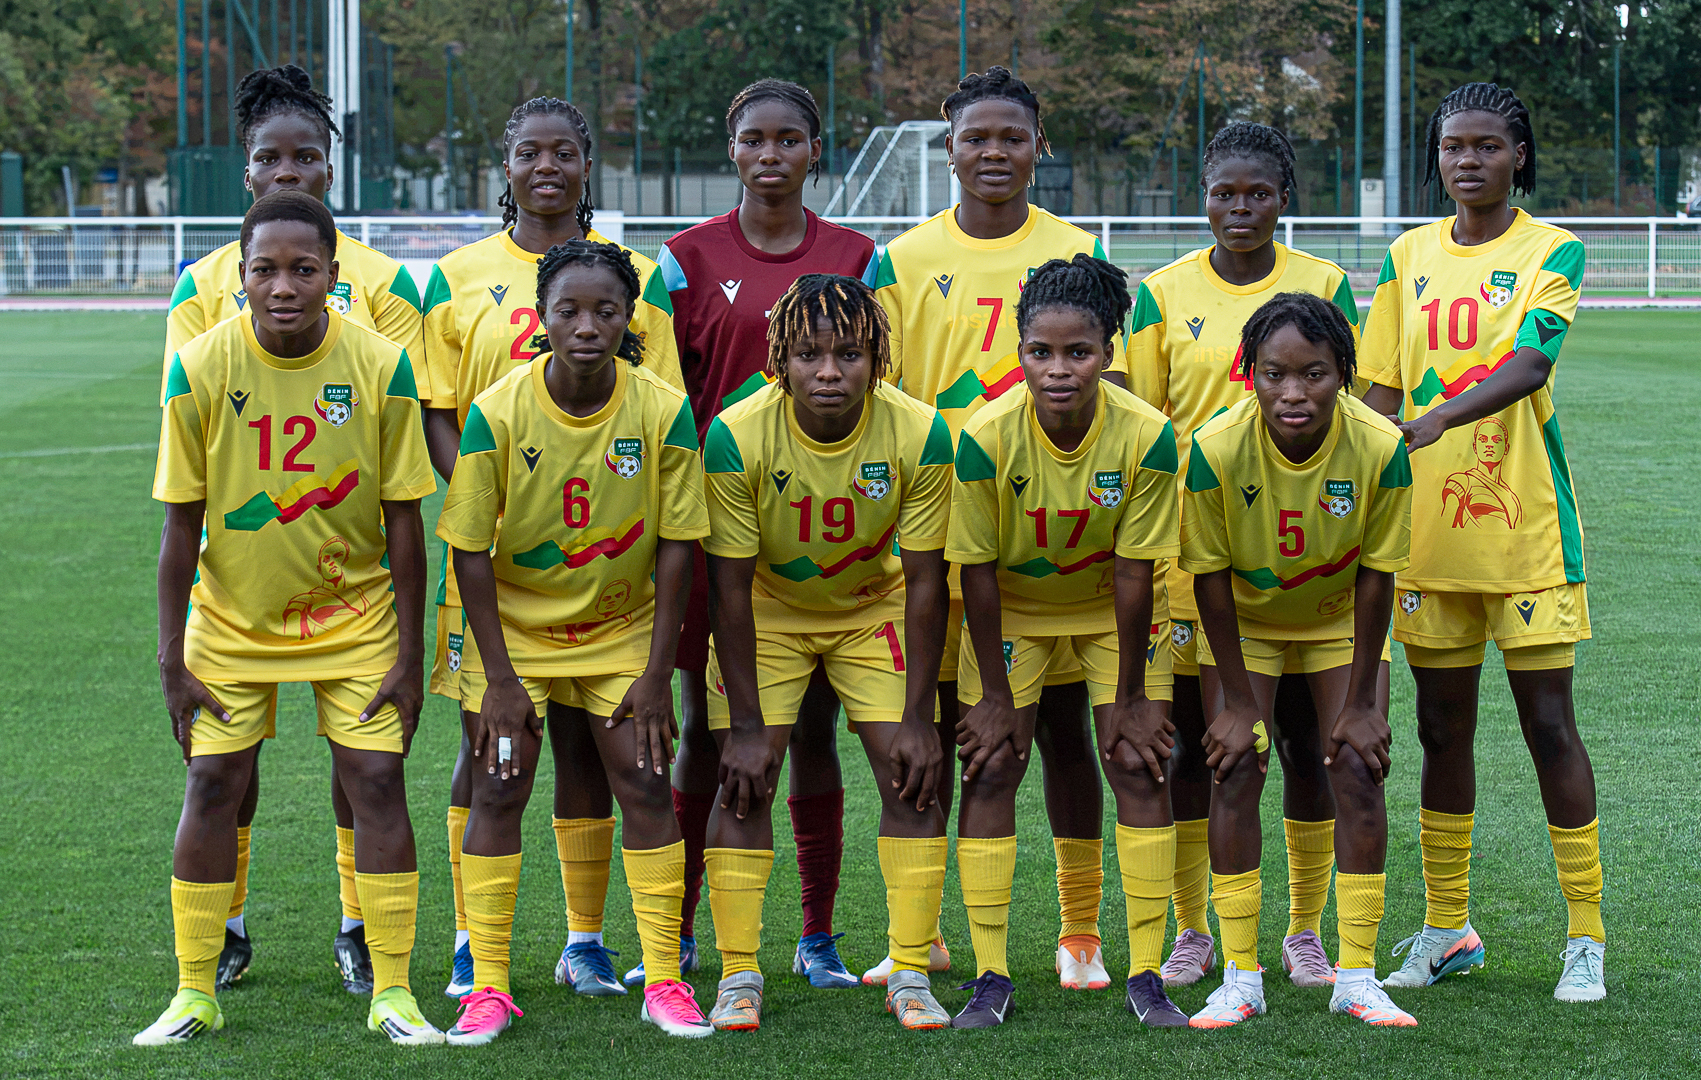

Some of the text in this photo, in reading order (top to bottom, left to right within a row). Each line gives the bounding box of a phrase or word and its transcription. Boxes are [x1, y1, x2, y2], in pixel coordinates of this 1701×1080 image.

[510, 307, 548, 360] 2
[977, 298, 1003, 352] 7
[1421, 297, 1479, 350] 10
[1229, 341, 1255, 391] 4
[248, 415, 317, 472] 12
[563, 477, 590, 529] 6
[789, 495, 855, 543] 19
[1026, 507, 1090, 549] 17
[1278, 509, 1305, 557] 5
